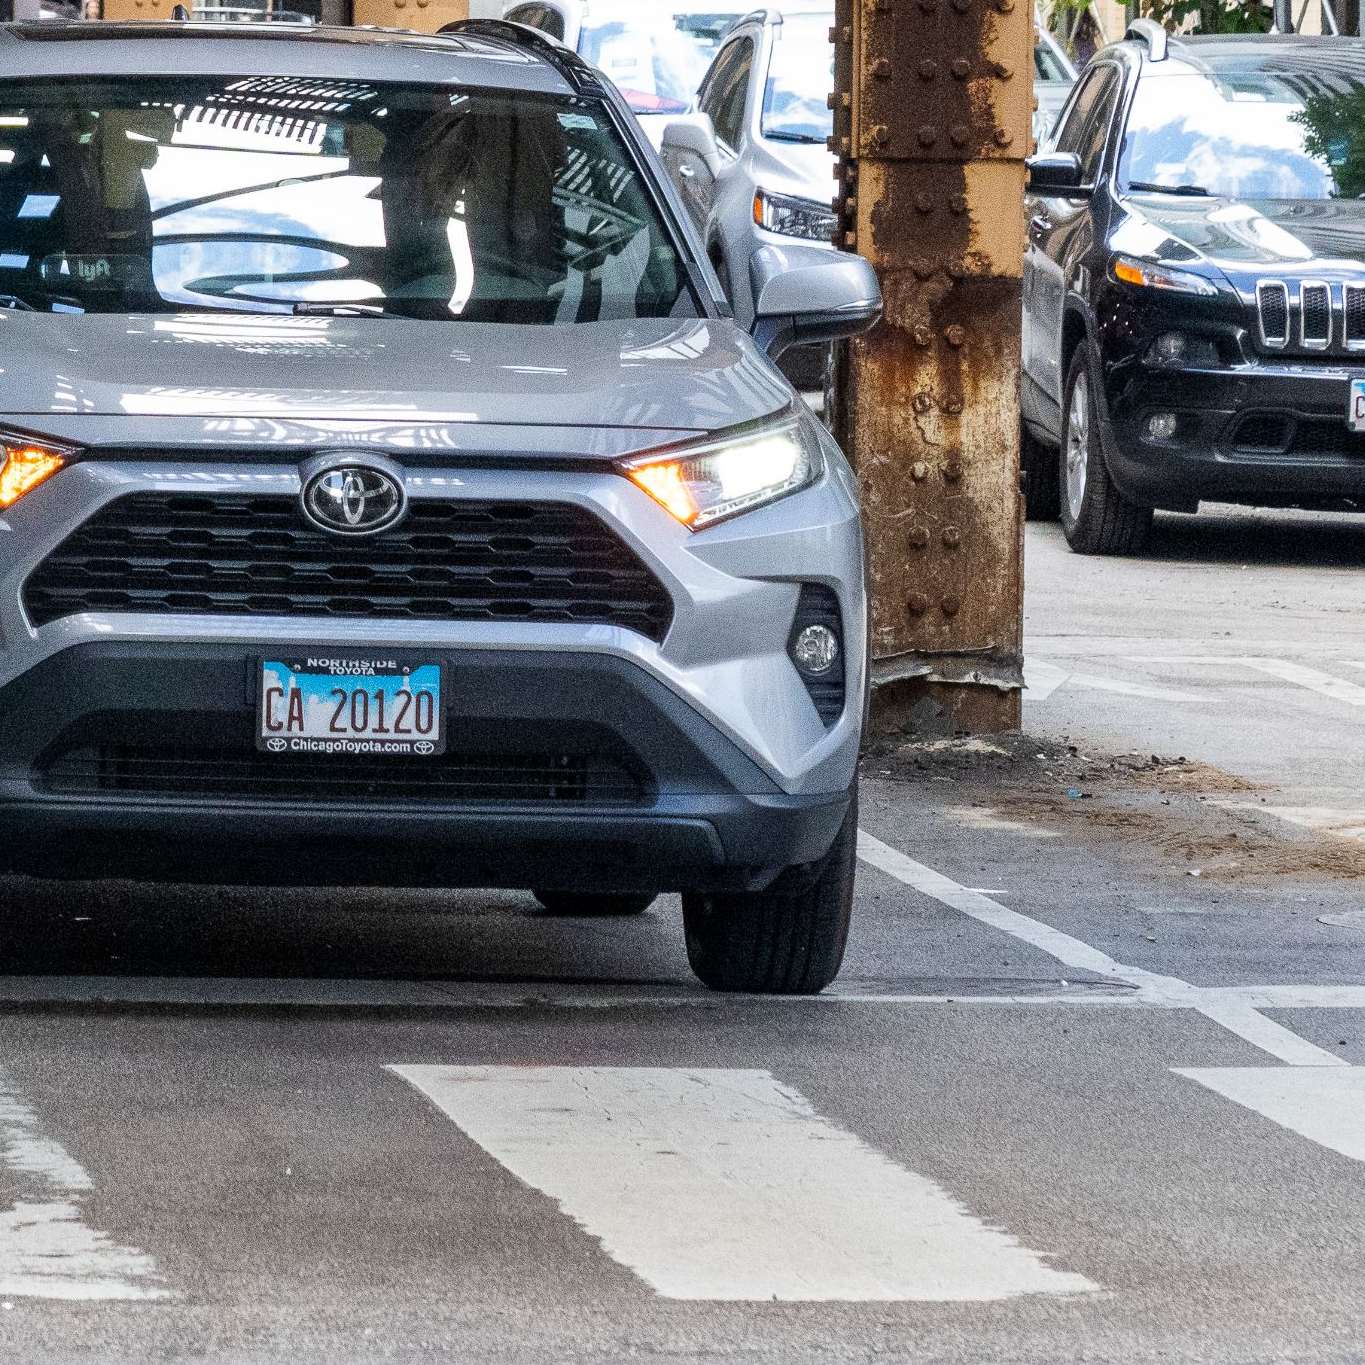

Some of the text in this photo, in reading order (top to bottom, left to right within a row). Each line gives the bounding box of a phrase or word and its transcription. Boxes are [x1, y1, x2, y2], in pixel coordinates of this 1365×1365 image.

[307, 658, 398, 669] NORTHSIDE
[329, 666, 376, 676] TOYOTA
[266, 686, 434, 735] CA 20120
[290, 738, 411, 754] ChicagoToyota.com
